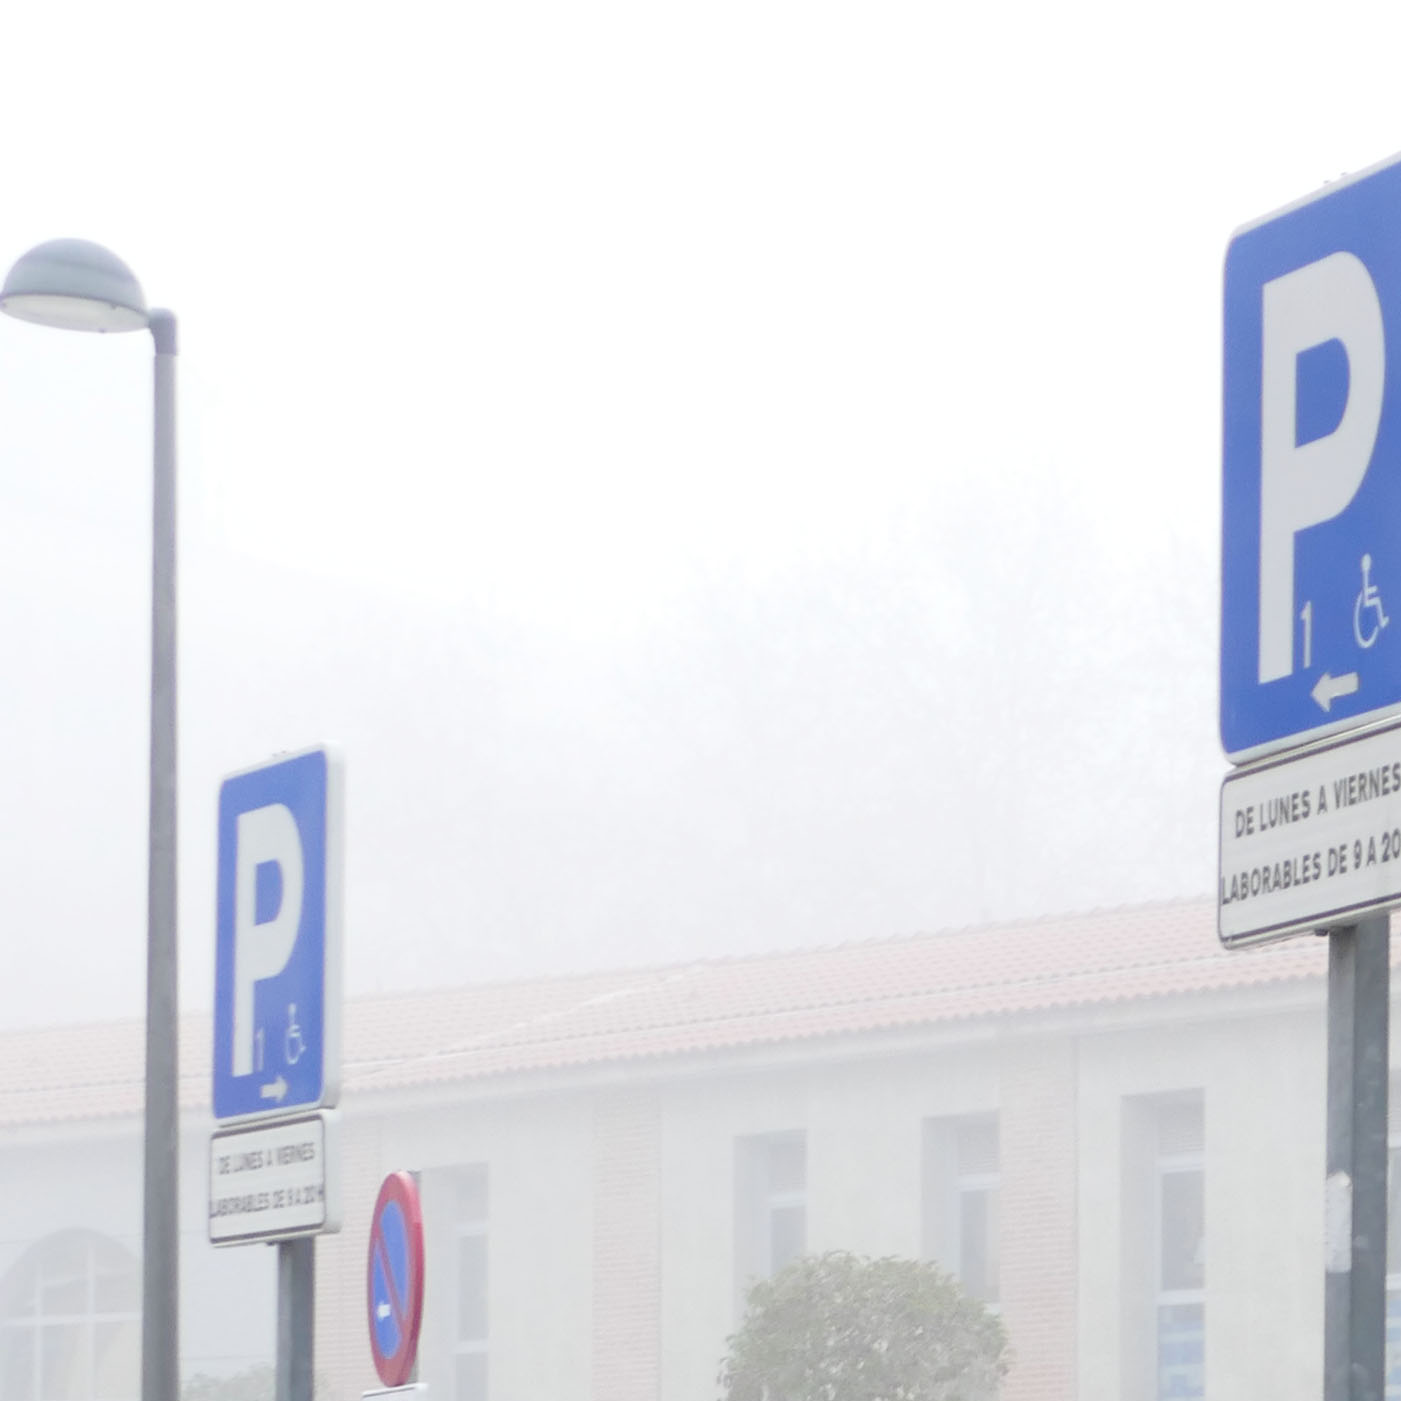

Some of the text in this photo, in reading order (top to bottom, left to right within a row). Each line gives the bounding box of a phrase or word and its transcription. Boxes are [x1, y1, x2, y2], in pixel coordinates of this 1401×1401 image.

[1258, 250, 1386, 685] P
[1221, 852, 1321, 905] LABORABLES
[1328, 844, 1347, 877] DE
[1354, 839, 1362, 870] 9
[1366, 836, 1376, 866] A
[1381, 828, 1401, 863] 20
[1235, 762, 1401, 838] DE LUNES A VIERNES
[232, 803, 304, 1078] P
